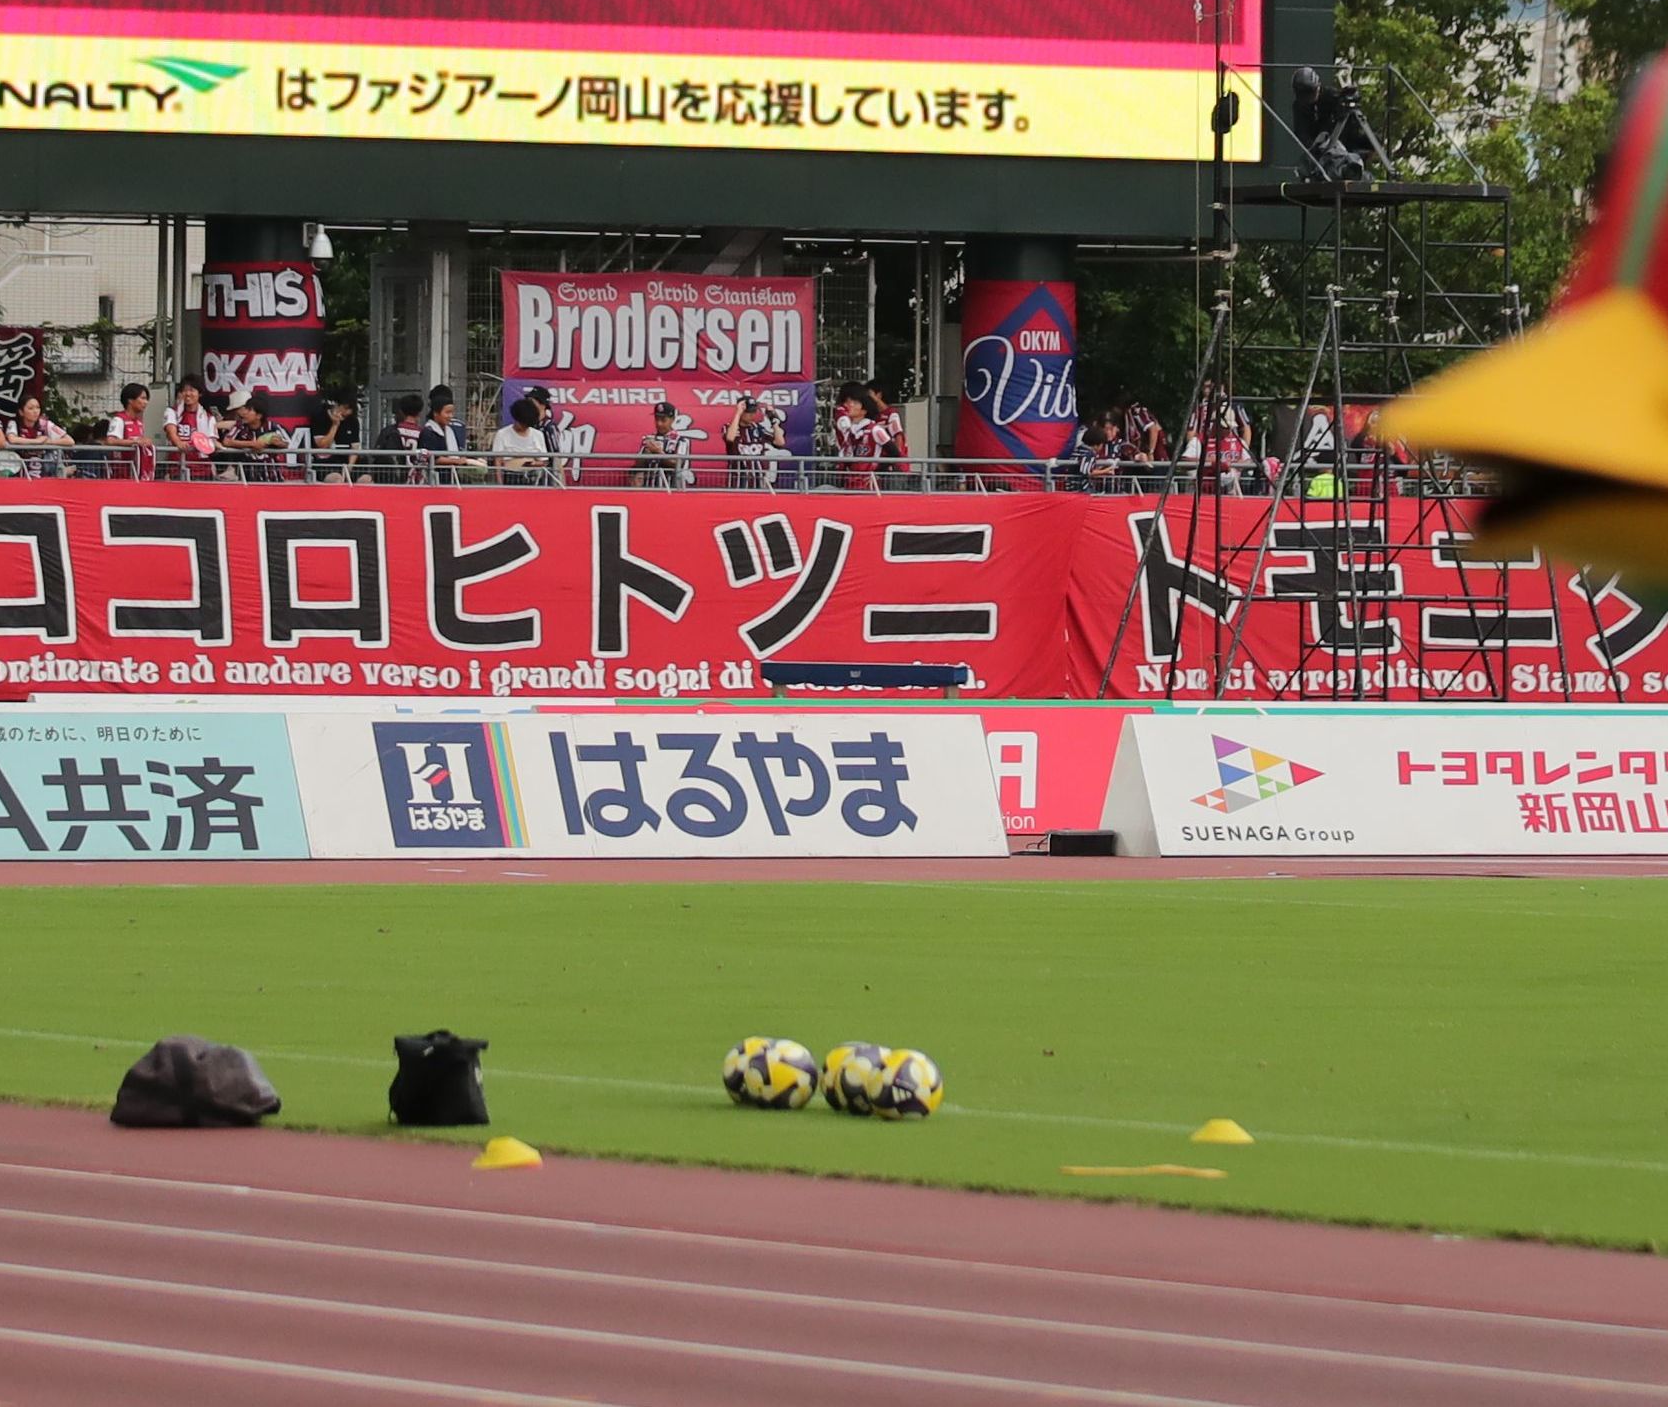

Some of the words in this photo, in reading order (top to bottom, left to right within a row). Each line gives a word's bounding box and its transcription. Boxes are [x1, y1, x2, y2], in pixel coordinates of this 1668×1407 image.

[276, 68, 1031, 134] はファジアーノ岡山を応援しています。
[204, 269, 309, 318] THIS
[517, 283, 803, 374] Brodersen
[1019, 330, 1061, 351] OKYM
[963, 334, 1079, 426] Vib
[168, 652, 216, 686] ad
[223, 654, 352, 688] andare
[364, 662, 462, 690] verso
[468, 659, 482, 690] i
[490, 659, 605, 698] grandi
[614, 659, 713, 698] sogni
[719, 658, 754, 690] di
[1135, 663, 1209, 693] Non
[1510, 663, 1630, 693] Siamo
[549, 731, 919, 839] はるやま
[408, 805, 486, 833] はるやま
[1002, 811, 1036, 830] ion
[1181, 825, 1291, 842] SUENAGA
[1294, 827, 1355, 845] Group
